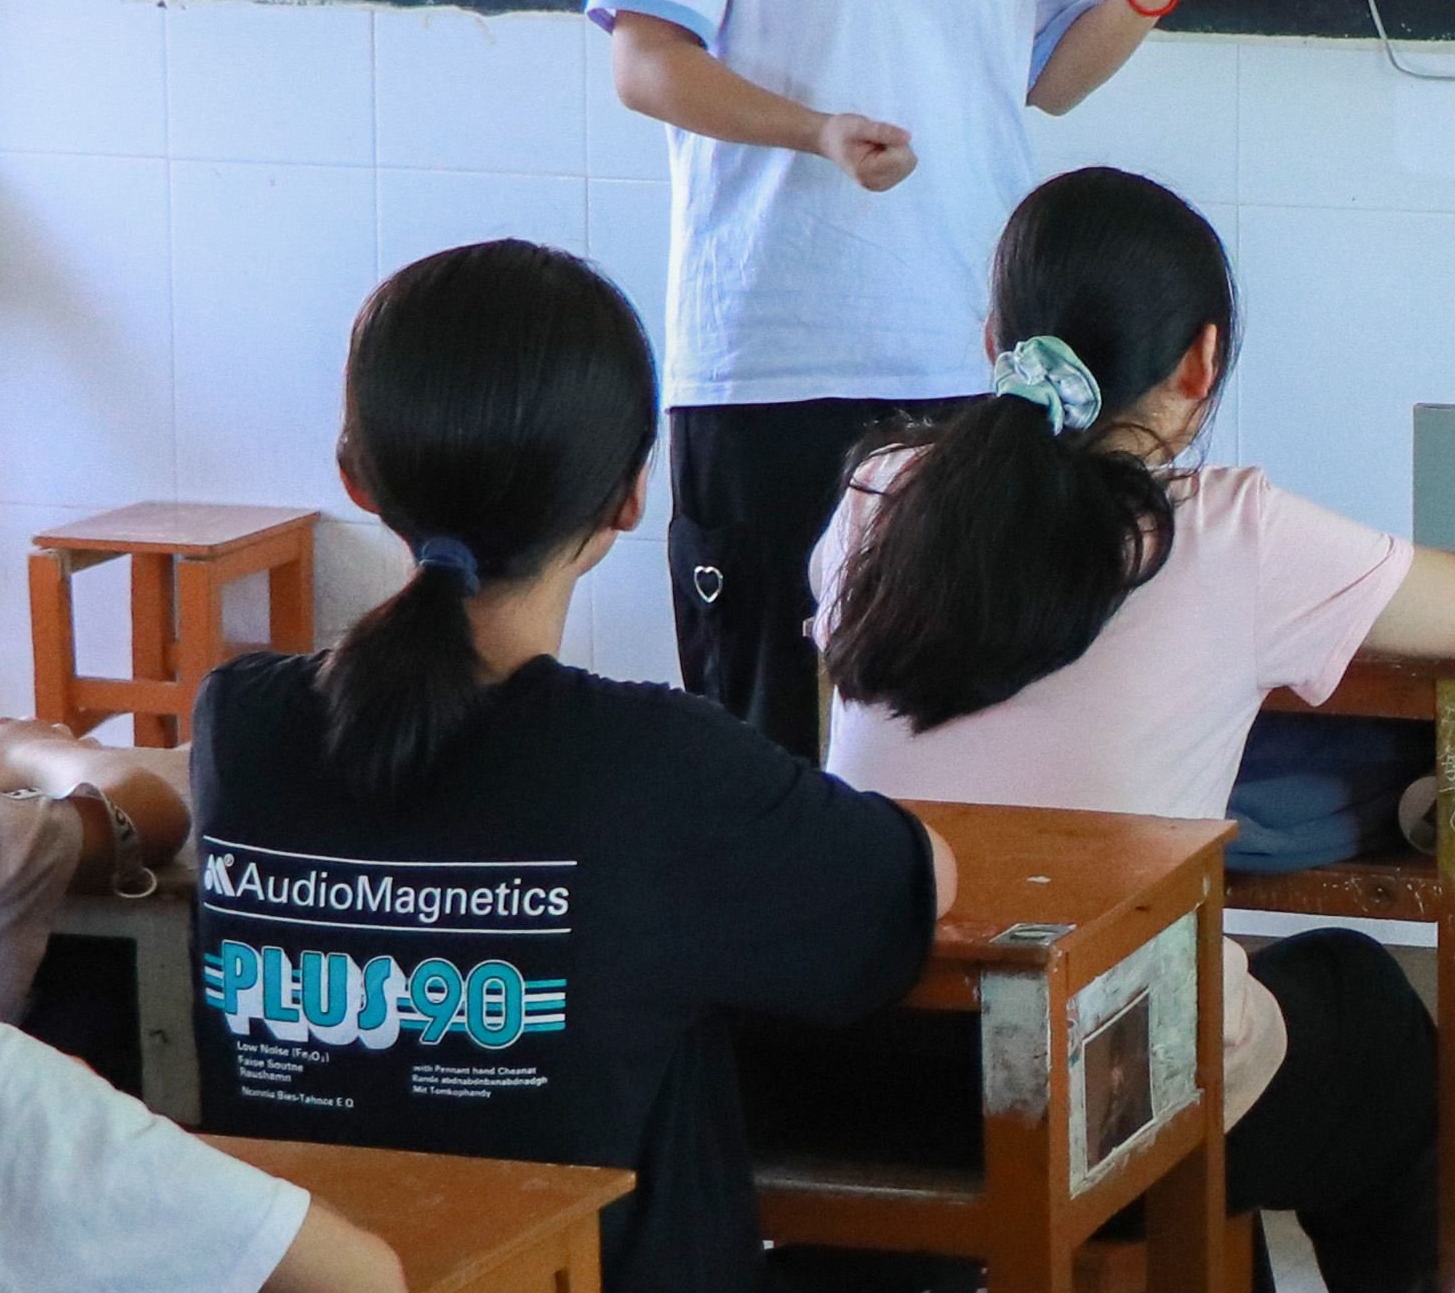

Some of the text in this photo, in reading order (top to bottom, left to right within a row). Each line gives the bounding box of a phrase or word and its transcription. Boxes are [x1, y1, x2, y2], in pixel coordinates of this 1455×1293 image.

[235, 861, 571, 925] AudioMagnetics
[220, 938, 526, 1050] PLUS 90
[236, 1040, 259, 1053] Low
